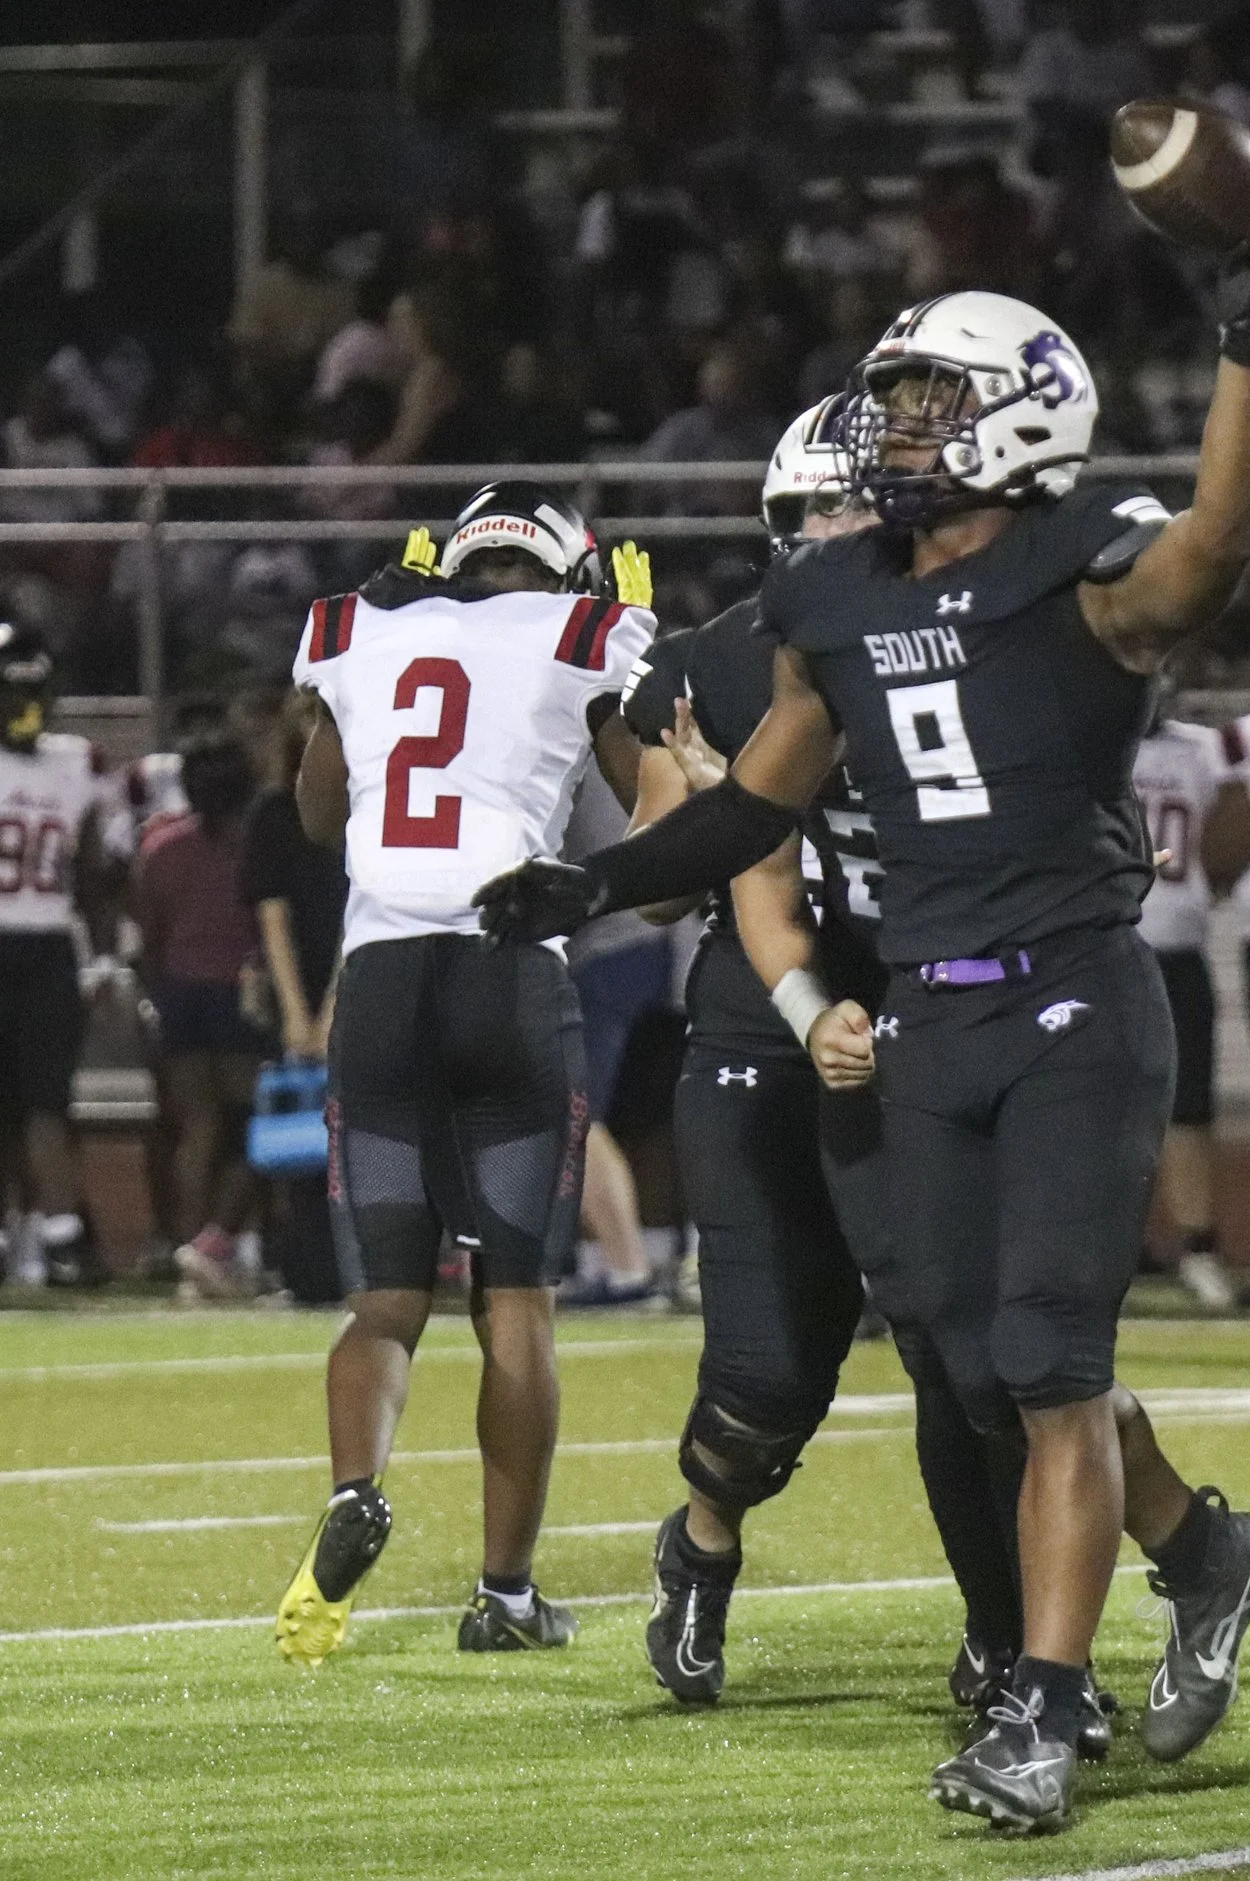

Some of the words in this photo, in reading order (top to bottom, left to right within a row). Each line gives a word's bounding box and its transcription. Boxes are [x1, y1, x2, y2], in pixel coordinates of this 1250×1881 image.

[456, 518, 537, 544] Riddell
[863, 625, 968, 676] SOUTH
[381, 656, 472, 850] 2
[886, 679, 992, 822] 9
